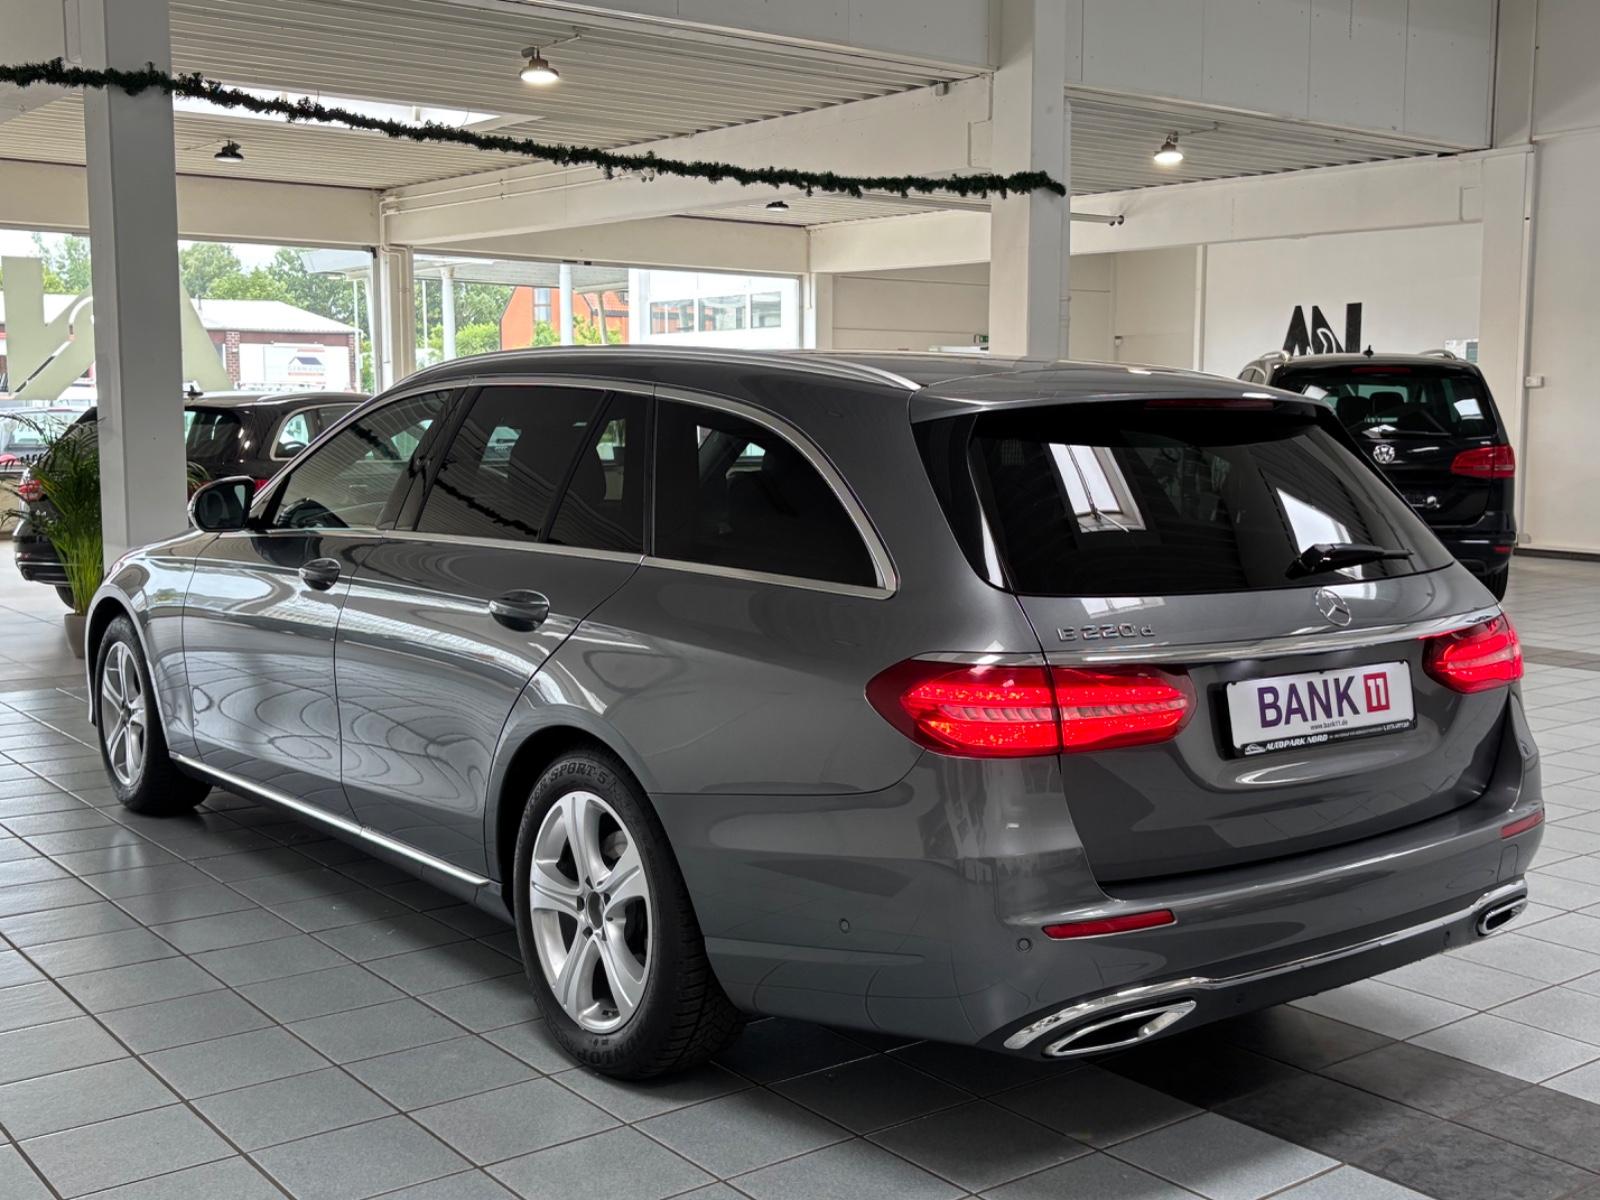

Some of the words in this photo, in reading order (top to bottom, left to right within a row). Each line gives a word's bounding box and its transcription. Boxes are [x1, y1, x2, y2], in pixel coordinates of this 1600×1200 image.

[1056, 626, 1077, 642] E
[1080, 623, 1137, 640] 220
[1140, 624, 1155, 638] d
[1257, 676, 1360, 728] BANK
[1266, 737, 1305, 750] AUTOPARK
[1306, 734, 1328, 744] NORD
[549, 762, 592, 782] SPORT
